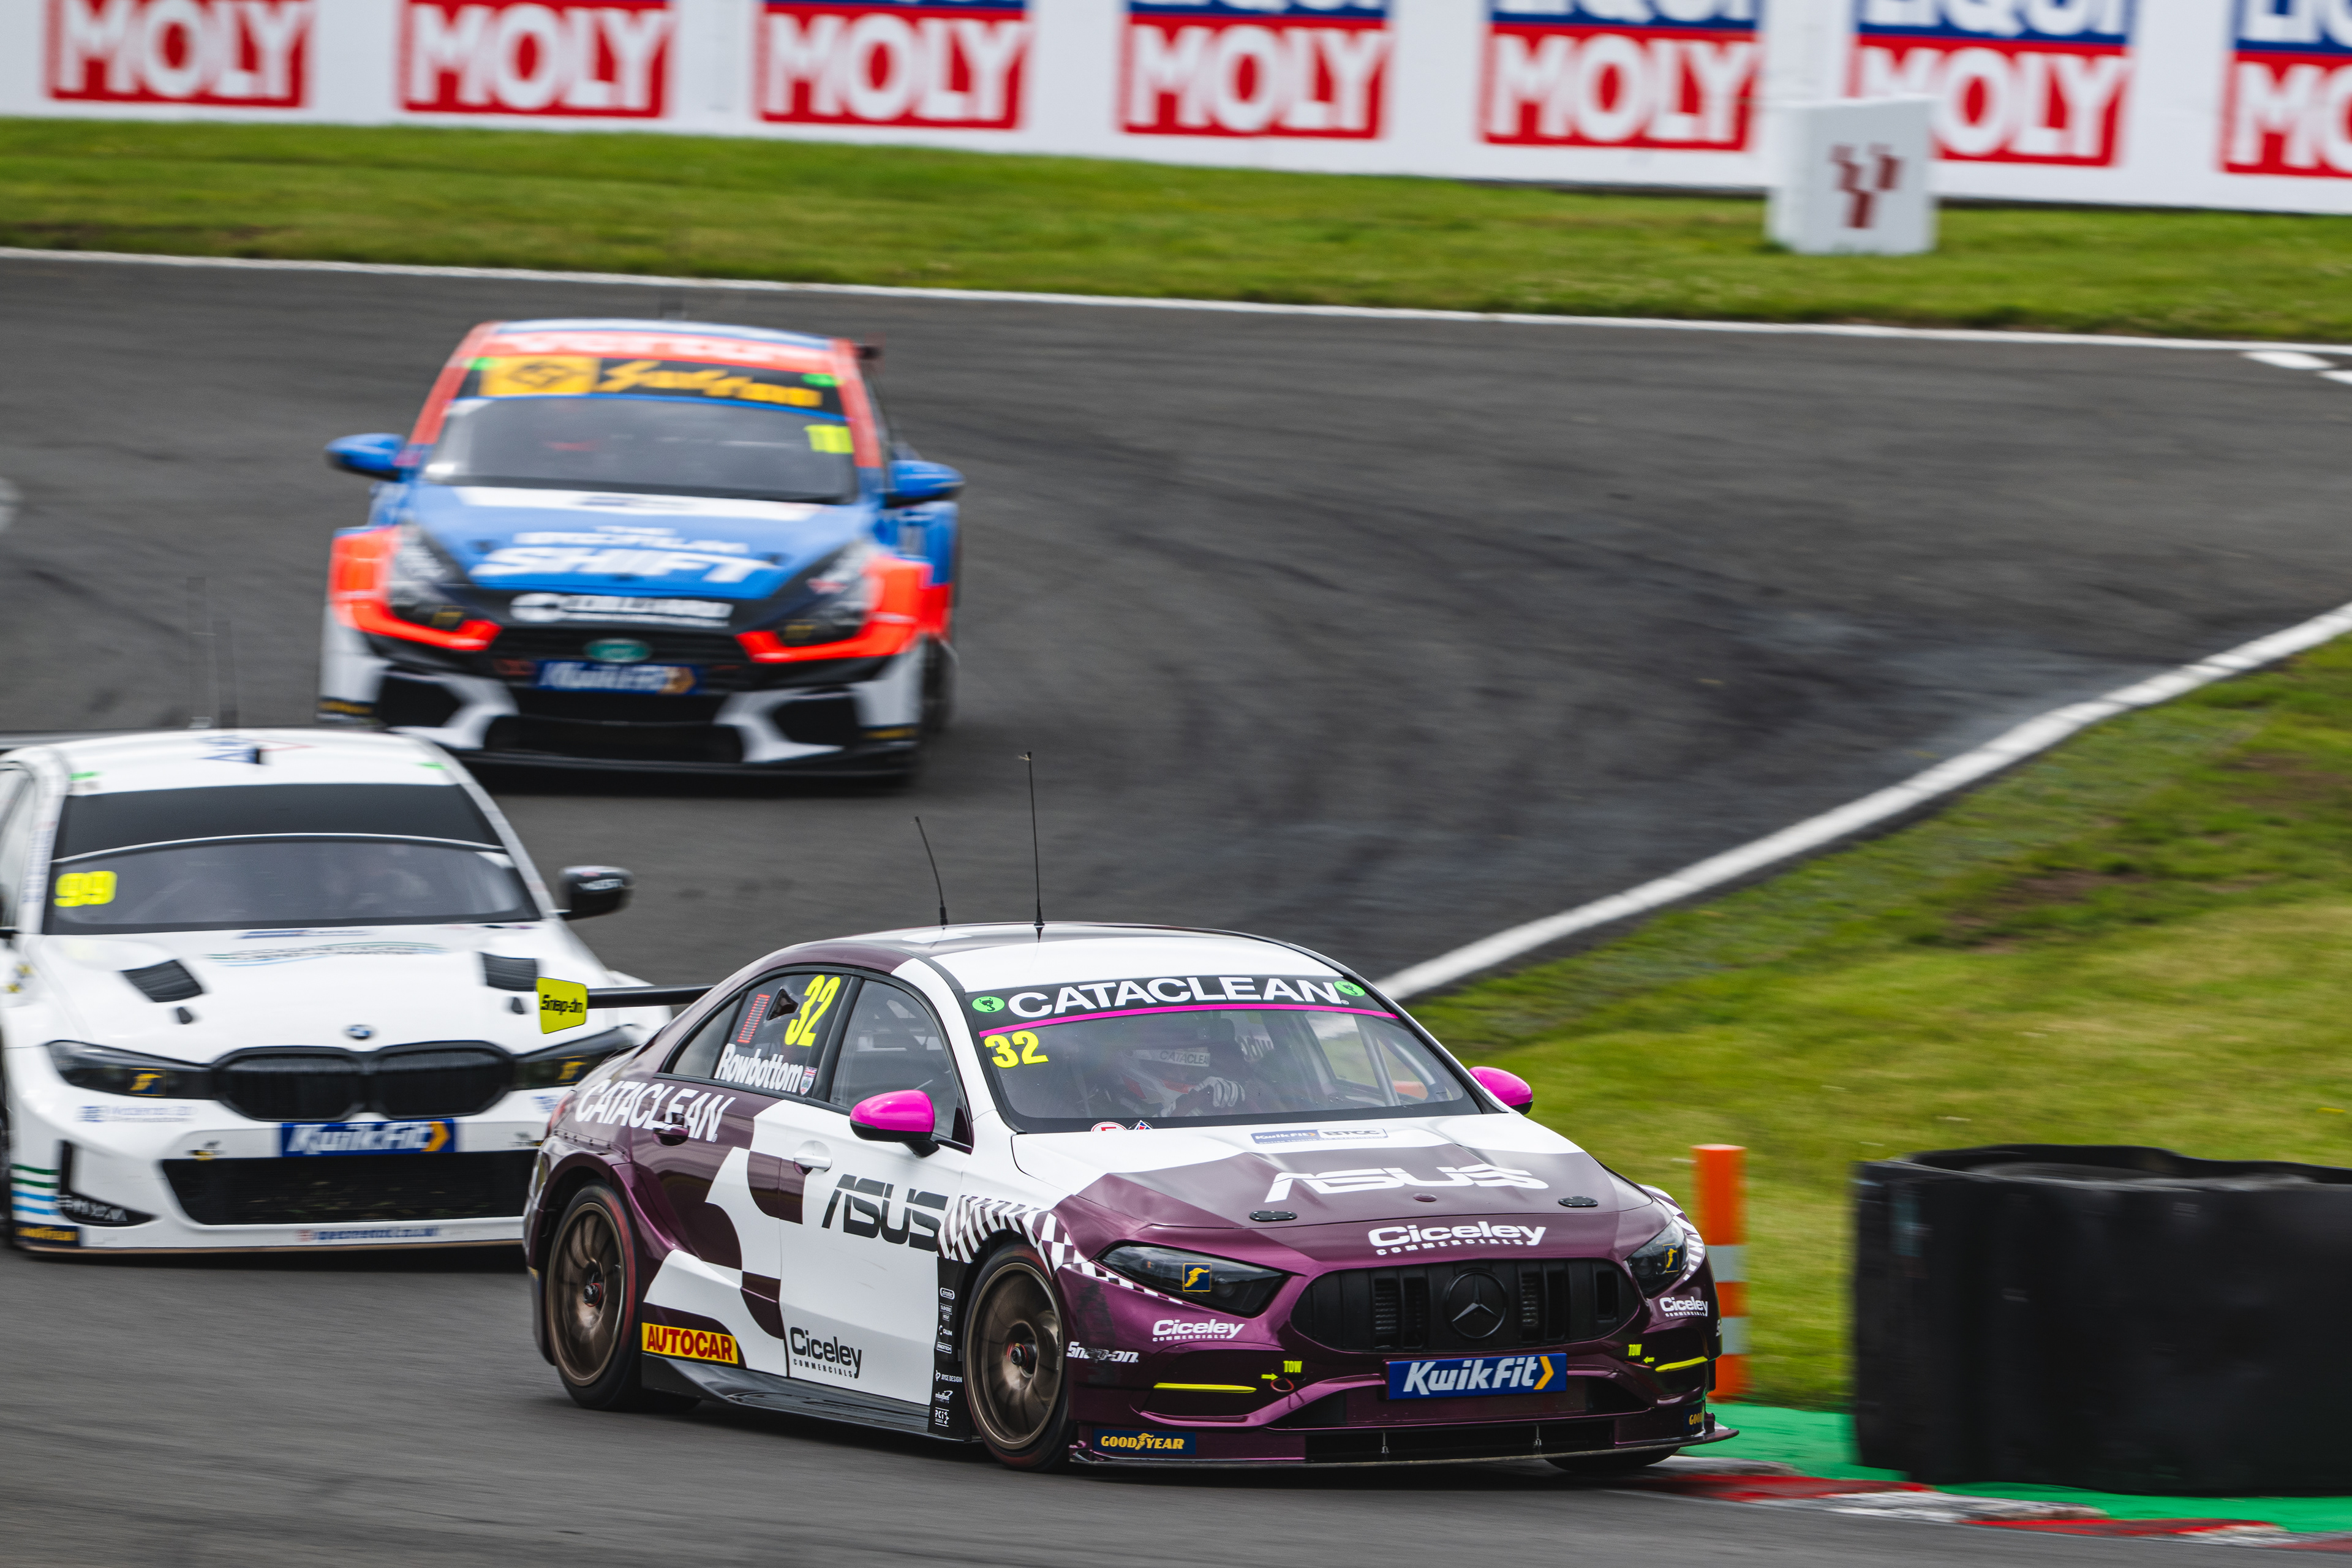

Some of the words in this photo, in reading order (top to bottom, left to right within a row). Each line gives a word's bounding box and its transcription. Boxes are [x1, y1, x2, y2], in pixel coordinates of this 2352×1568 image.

[60, 0, 309, 99] MOLY
[409, 2, 670, 110] MOLY
[767, 12, 1028, 123] MOLY
[1128, 23, 1392, 134] MOLY
[1494, 33, 1763, 142] MOLY
[469, 547, 783, 582] SHIFT
[53, 871, 118, 907] 99
[785, 975, 840, 1047] 32
[1008, 976, 1342, 1018] CATACLEAN
[714, 1043, 804, 1093] Rowbottom
[984, 1031, 1049, 1068] 32
[575, 1079, 736, 1142] CATACLEAN
[1264, 1164, 1549, 1203] ASUS
[821, 1174, 949, 1252] ASUS
[1368, 1221, 1547, 1248] Ciceley
[1376, 1239, 1523, 1256] COMMERCIALS
[1659, 1296, 1708, 1317] Ciceley
[646, 1325, 733, 1361] AUTOCAR
[1153, 1319, 1245, 1339] Ciceley
[790, 1327, 862, 1379] Ciceley
[794, 1359, 853, 1378] COMMERCIALS
[1283, 1360, 1302, 1373] TOW
